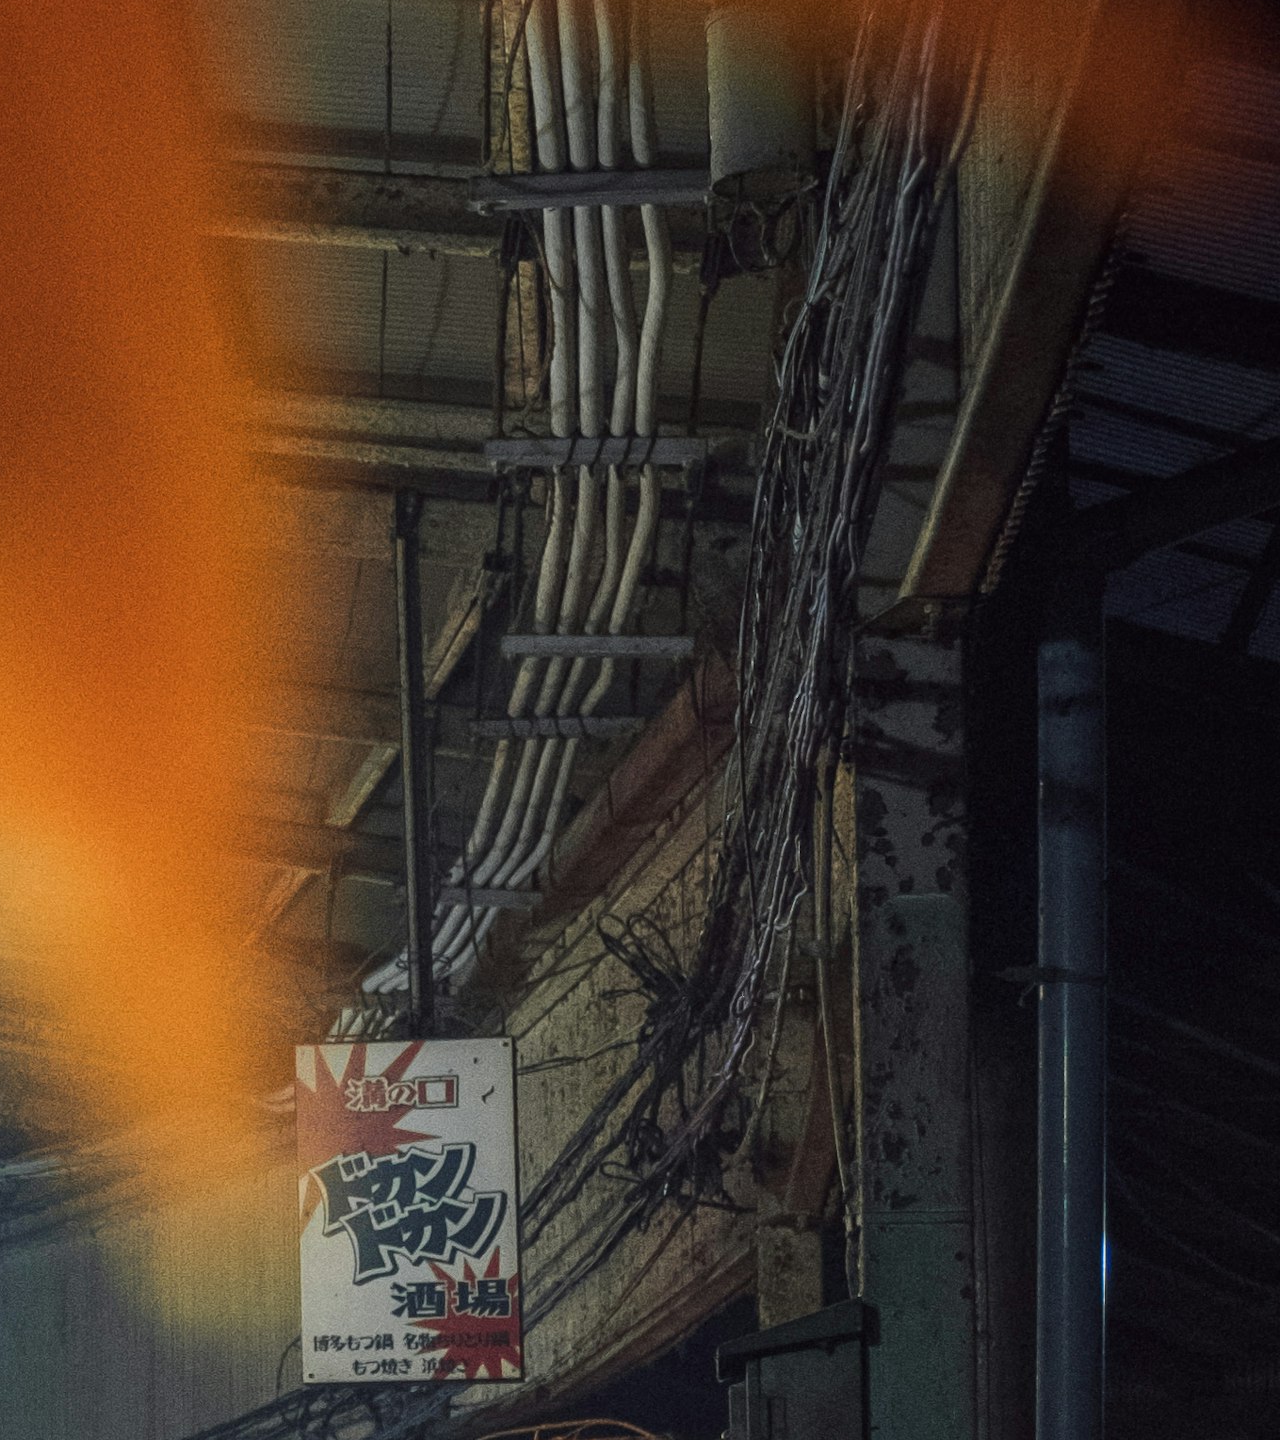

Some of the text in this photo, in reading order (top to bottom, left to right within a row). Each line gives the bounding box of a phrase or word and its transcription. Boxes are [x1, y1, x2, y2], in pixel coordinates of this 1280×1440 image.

[348, 1076, 459, 1111] 溝の口
[391, 1279, 511, 1318] 酒場
